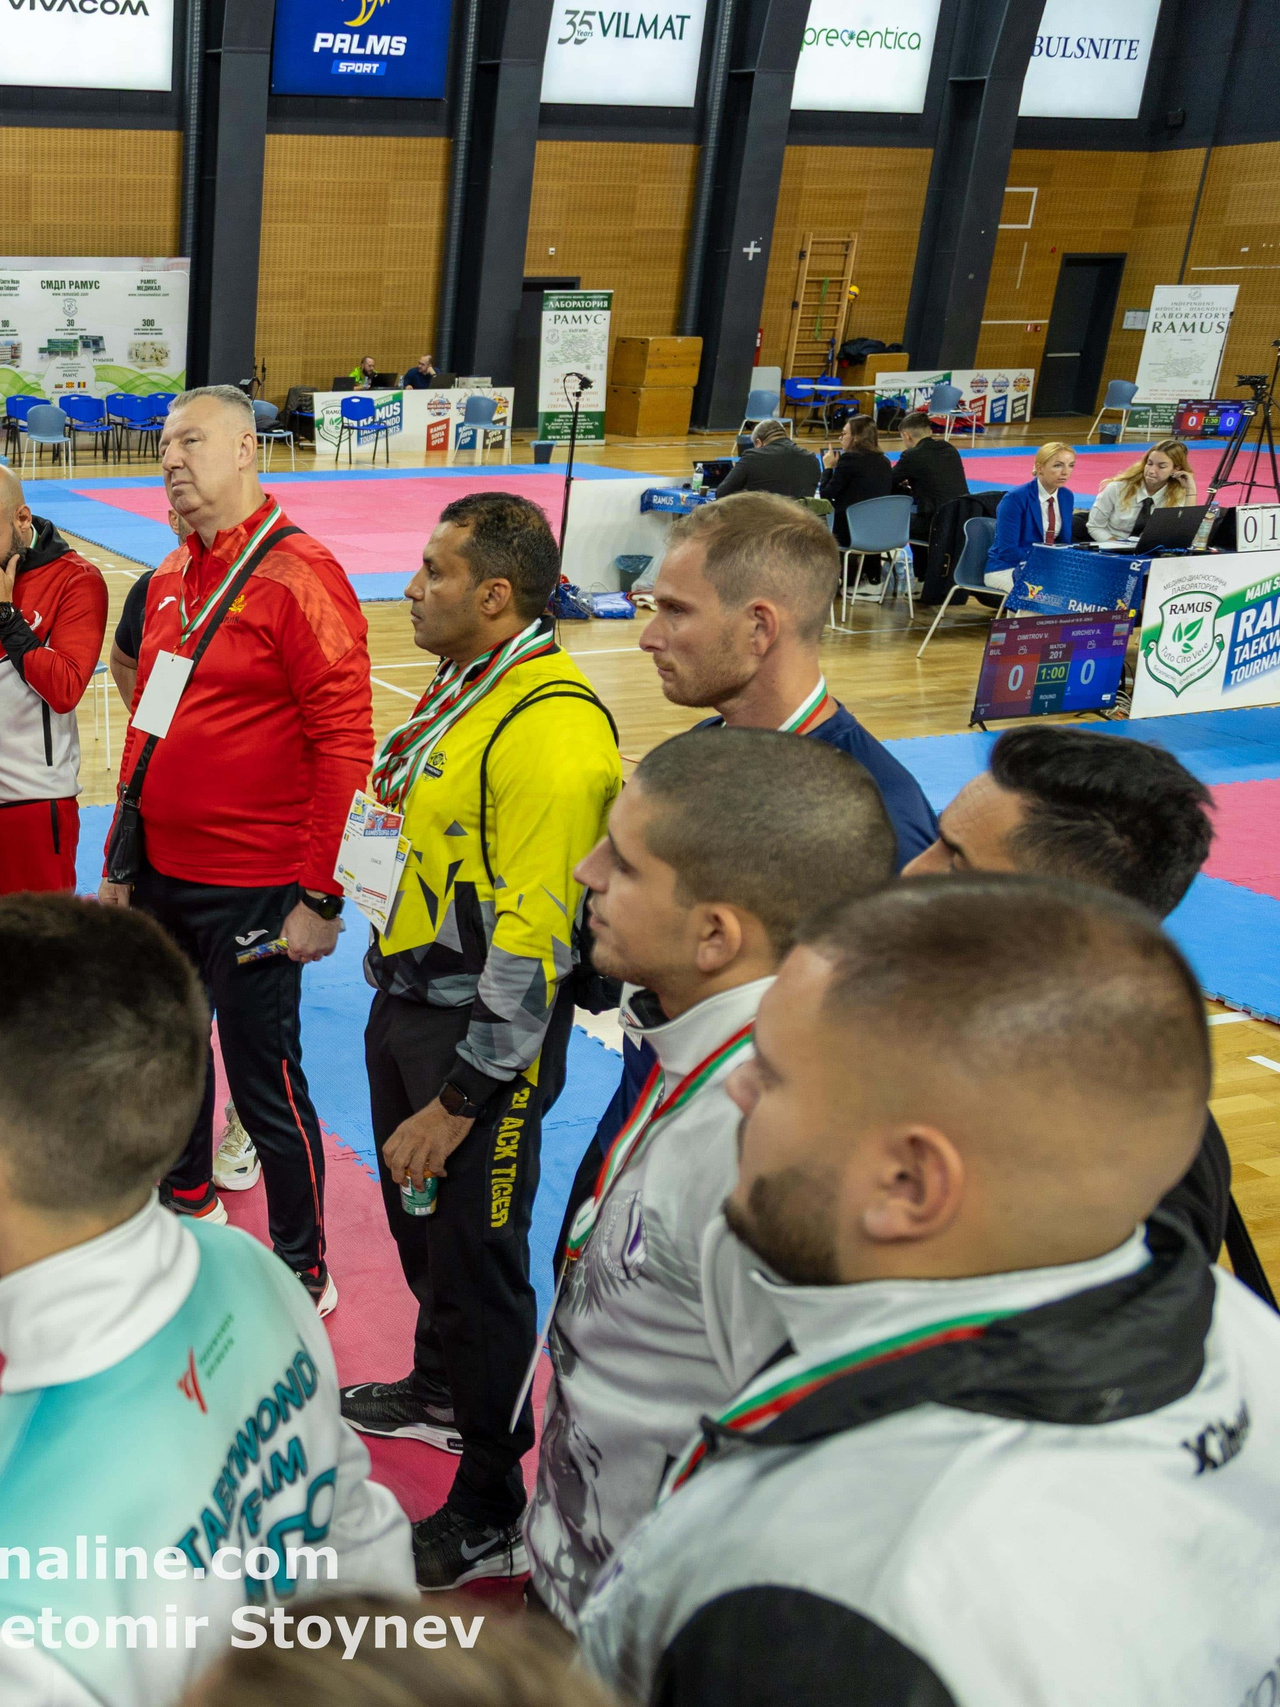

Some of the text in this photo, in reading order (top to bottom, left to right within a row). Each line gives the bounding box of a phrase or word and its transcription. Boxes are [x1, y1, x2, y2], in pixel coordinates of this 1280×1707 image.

[8, 0, 150, 16] VIVACOM
[557, 9, 691, 45] 35 VILMAT
[313, 32, 408, 56] PALMS
[1031, 35, 1141, 61] BULSNITE
[338, 62, 380, 74] SPORT
[40, 280, 100, 290] СМДЛ РАМУС
[66, 319, 75, 327] 30
[142, 319, 155, 327] 300
[1151, 321, 1226, 334] RAMUS
[1187, 415, 1197, 427] 0
[1225, 417, 1234, 427] 0
[653, 495, 674, 506] RAMUS
[1172, 582, 1219, 595] ЛАБОРАТОРИЯ
[1245, 586, 1271, 602] MAIN
[1169, 601, 1213, 615] RAMUS
[1017, 633, 1042, 641] DIMITROV
[1071, 629, 1092, 637] KIRCHEV
[1049, 651, 1063, 659] 201
[1161, 642, 1209, 664] Tuto Cito Vere
[1008, 664, 1024, 691] 0
[1040, 667, 1066, 679] 1:00
[1080, 659, 1095, 685] 0
[491, 1163, 517, 1228] TIGER
